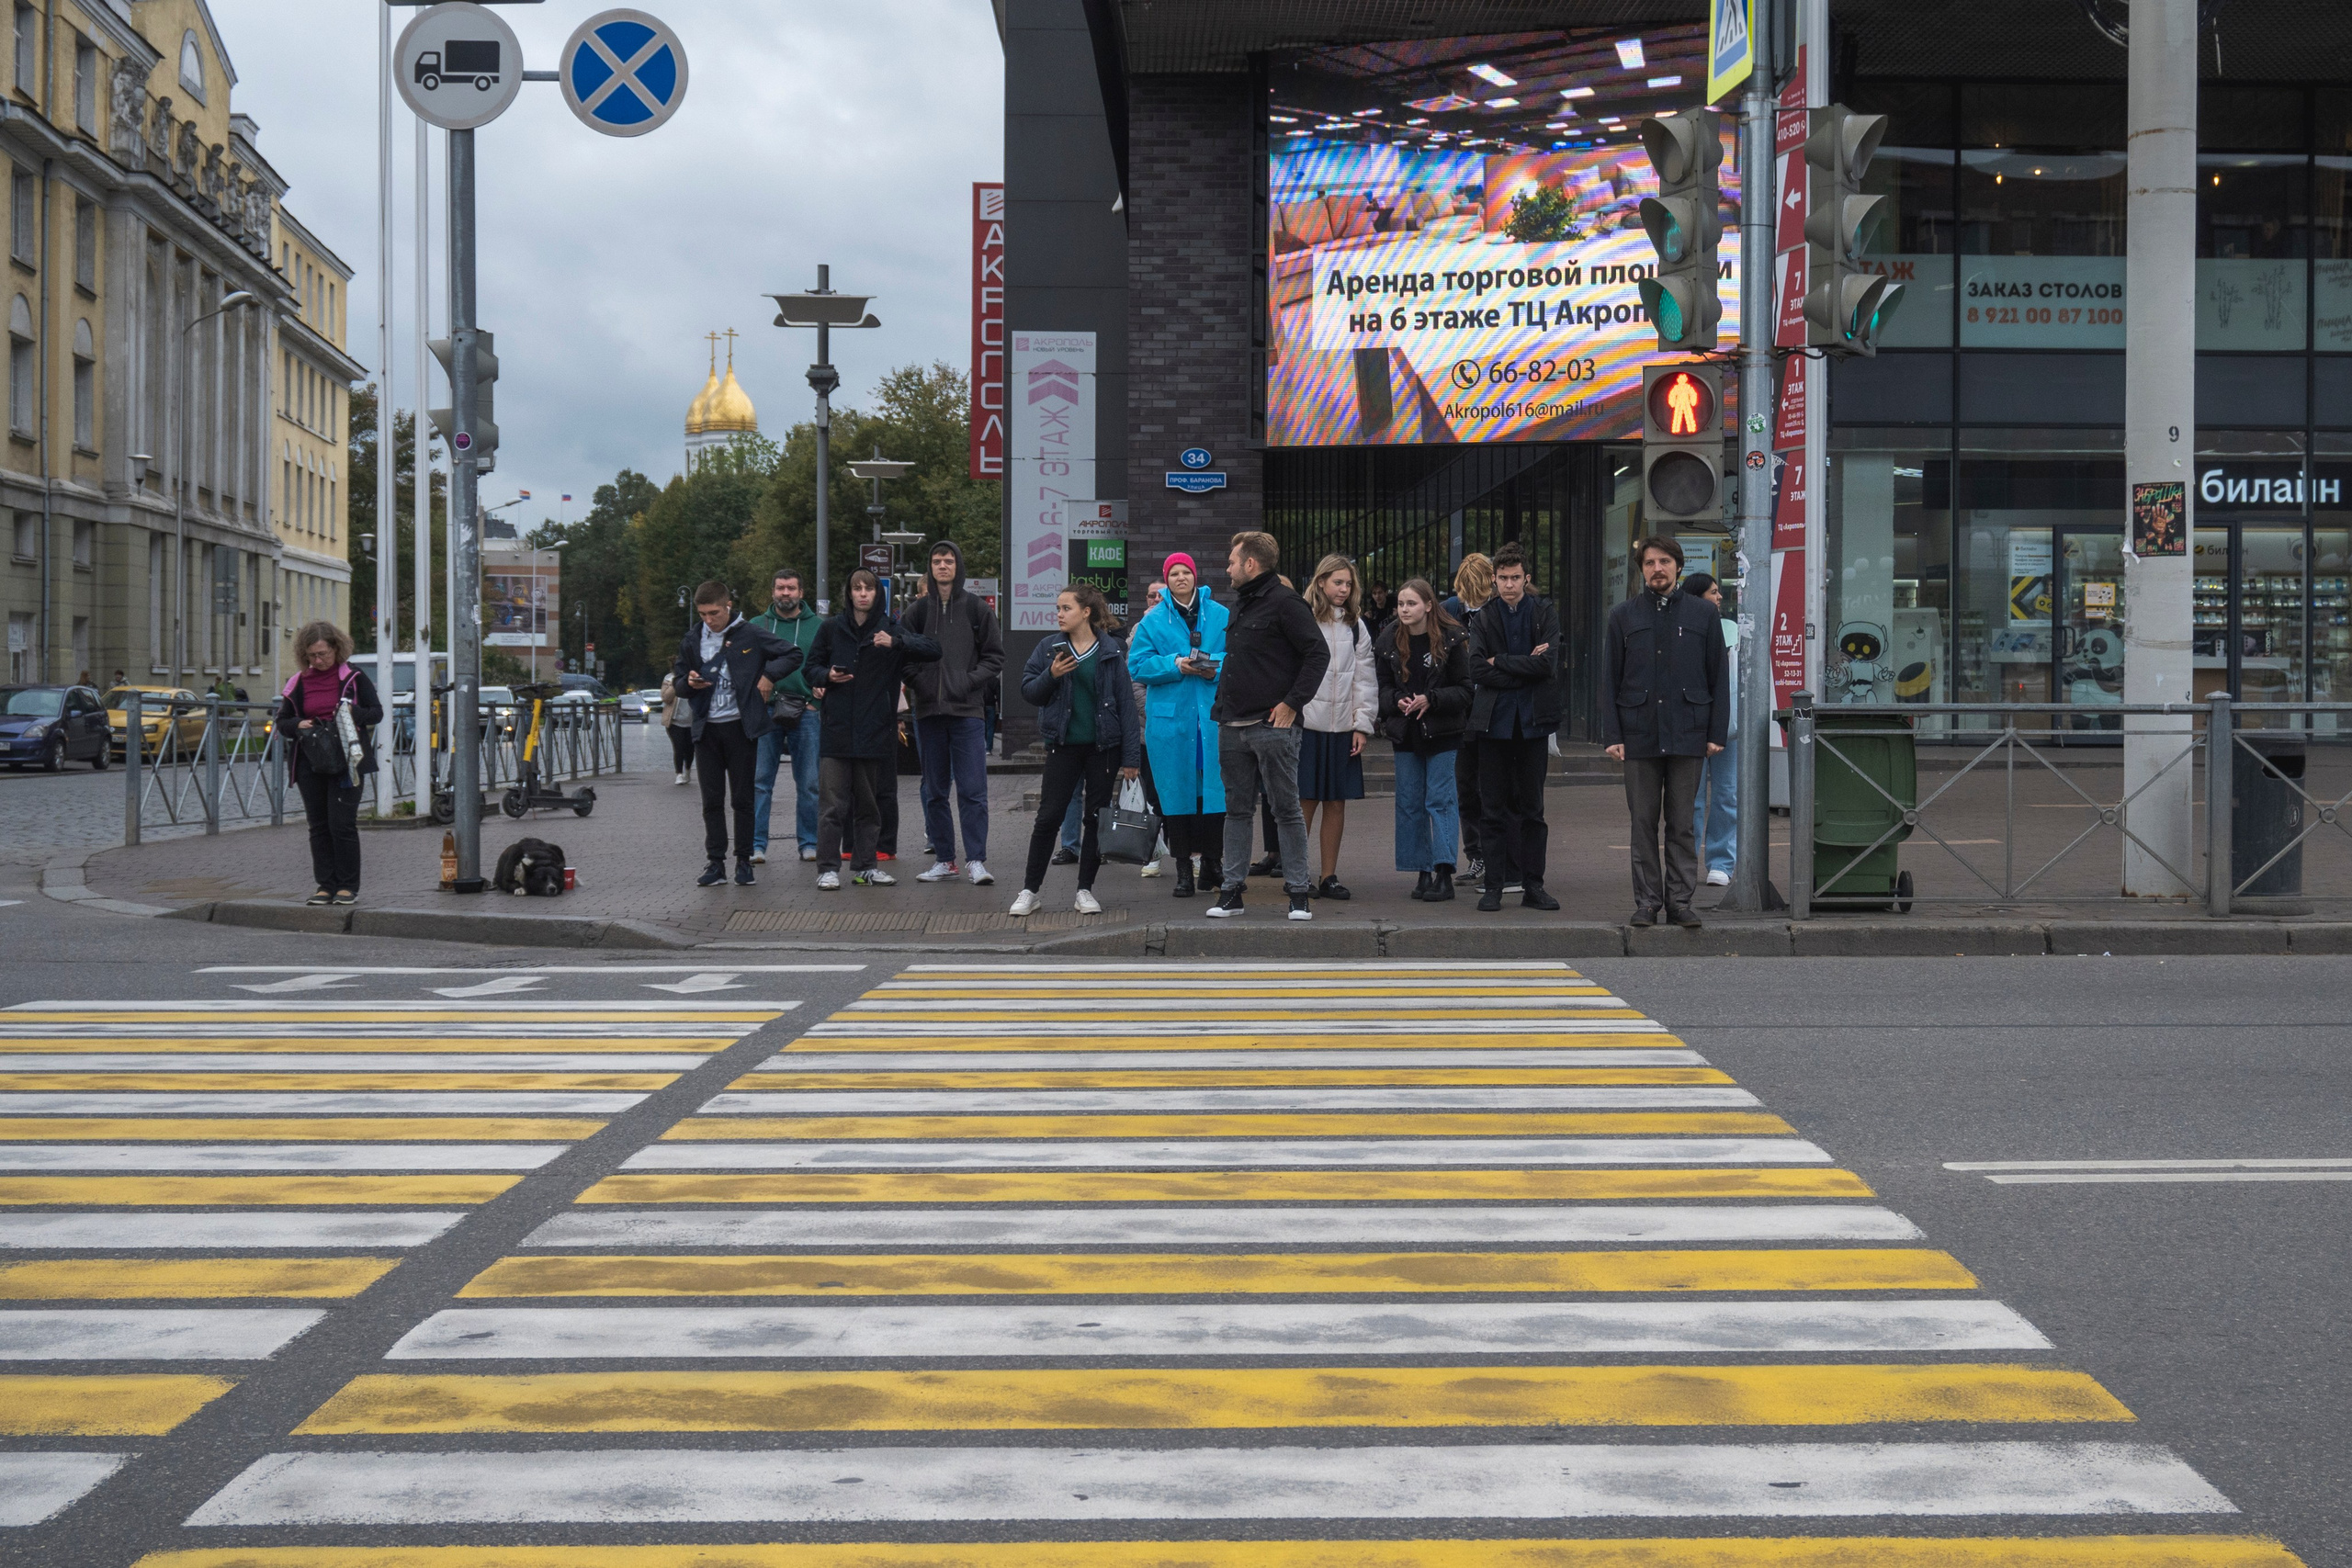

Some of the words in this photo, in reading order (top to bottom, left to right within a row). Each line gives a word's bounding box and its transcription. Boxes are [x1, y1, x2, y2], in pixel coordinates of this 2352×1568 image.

[1777, 121, 1801, 142] 410-520
[1859, 260, 1916, 281] ТАЖ
[1326, 269, 1435, 301] Аренда
[1442, 259, 1582, 296] торговой
[1794, 270, 1802, 291] 7
[1967, 282, 2033, 299] ЗАКАЗ
[2039, 282, 2123, 299] СТОЛОВ
[1349, 311, 1383, 333] на
[1390, 307, 1408, 332] 6
[1414, 307, 1501, 331] этаже
[1508, 299, 1548, 332] ТЦ
[1555, 299, 1650, 332] Акроп
[1967, 307, 1980, 323] 8
[1985, 307, 2019, 323] 921
[2026, 308, 2052, 324] 00
[2058, 308, 2082, 324] 87
[2087, 308, 2123, 324] 100
[1033, 338, 1093, 346] АКРОПОЛЬ
[1489, 358, 1596, 384] 66-82-03
[1794, 357, 1800, 378] 1
[1788, 380, 1804, 396] ЭТАЖ
[1444, 400, 1605, 423] Akropol616@mail.ru
[1039, 405, 1069, 477] ЭТАЖ
[2168, 425, 2180, 443] 9
[1187, 452, 1205, 465] 34
[1794, 465, 1803, 486] 7
[1039, 486, 1069, 525] 6-7
[1079, 520, 1128, 528] АКРОПОЛЬ
[1089, 547, 1122, 561] КАФЕ
[2207, 544, 2249, 556] билн
[1033, 583, 1062, 592] АКРО
[1070, 571, 1128, 593] tastyla
[1119, 590, 1128, 598] GR
[1019, 610, 1057, 626] ЛИФ
[1781, 613, 1788, 631] 2
[1775, 634, 1792, 647] ЭТАЖ
